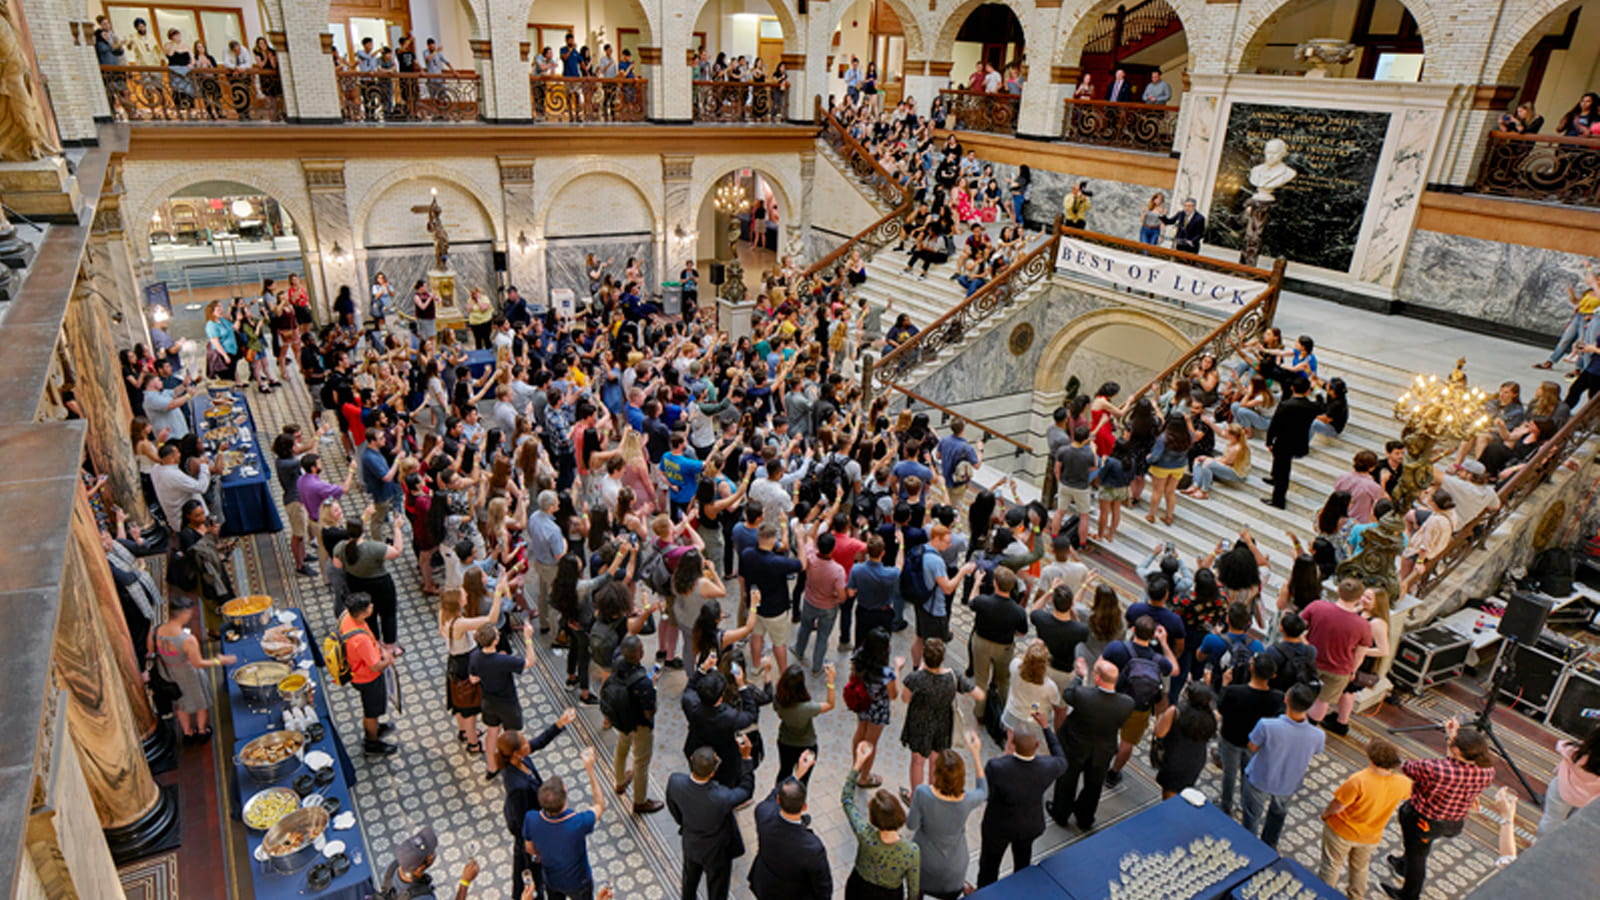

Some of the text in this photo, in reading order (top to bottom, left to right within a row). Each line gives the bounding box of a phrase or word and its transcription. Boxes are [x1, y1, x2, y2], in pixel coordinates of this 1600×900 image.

[1062, 247, 1246, 305] BEST OF LUCK
